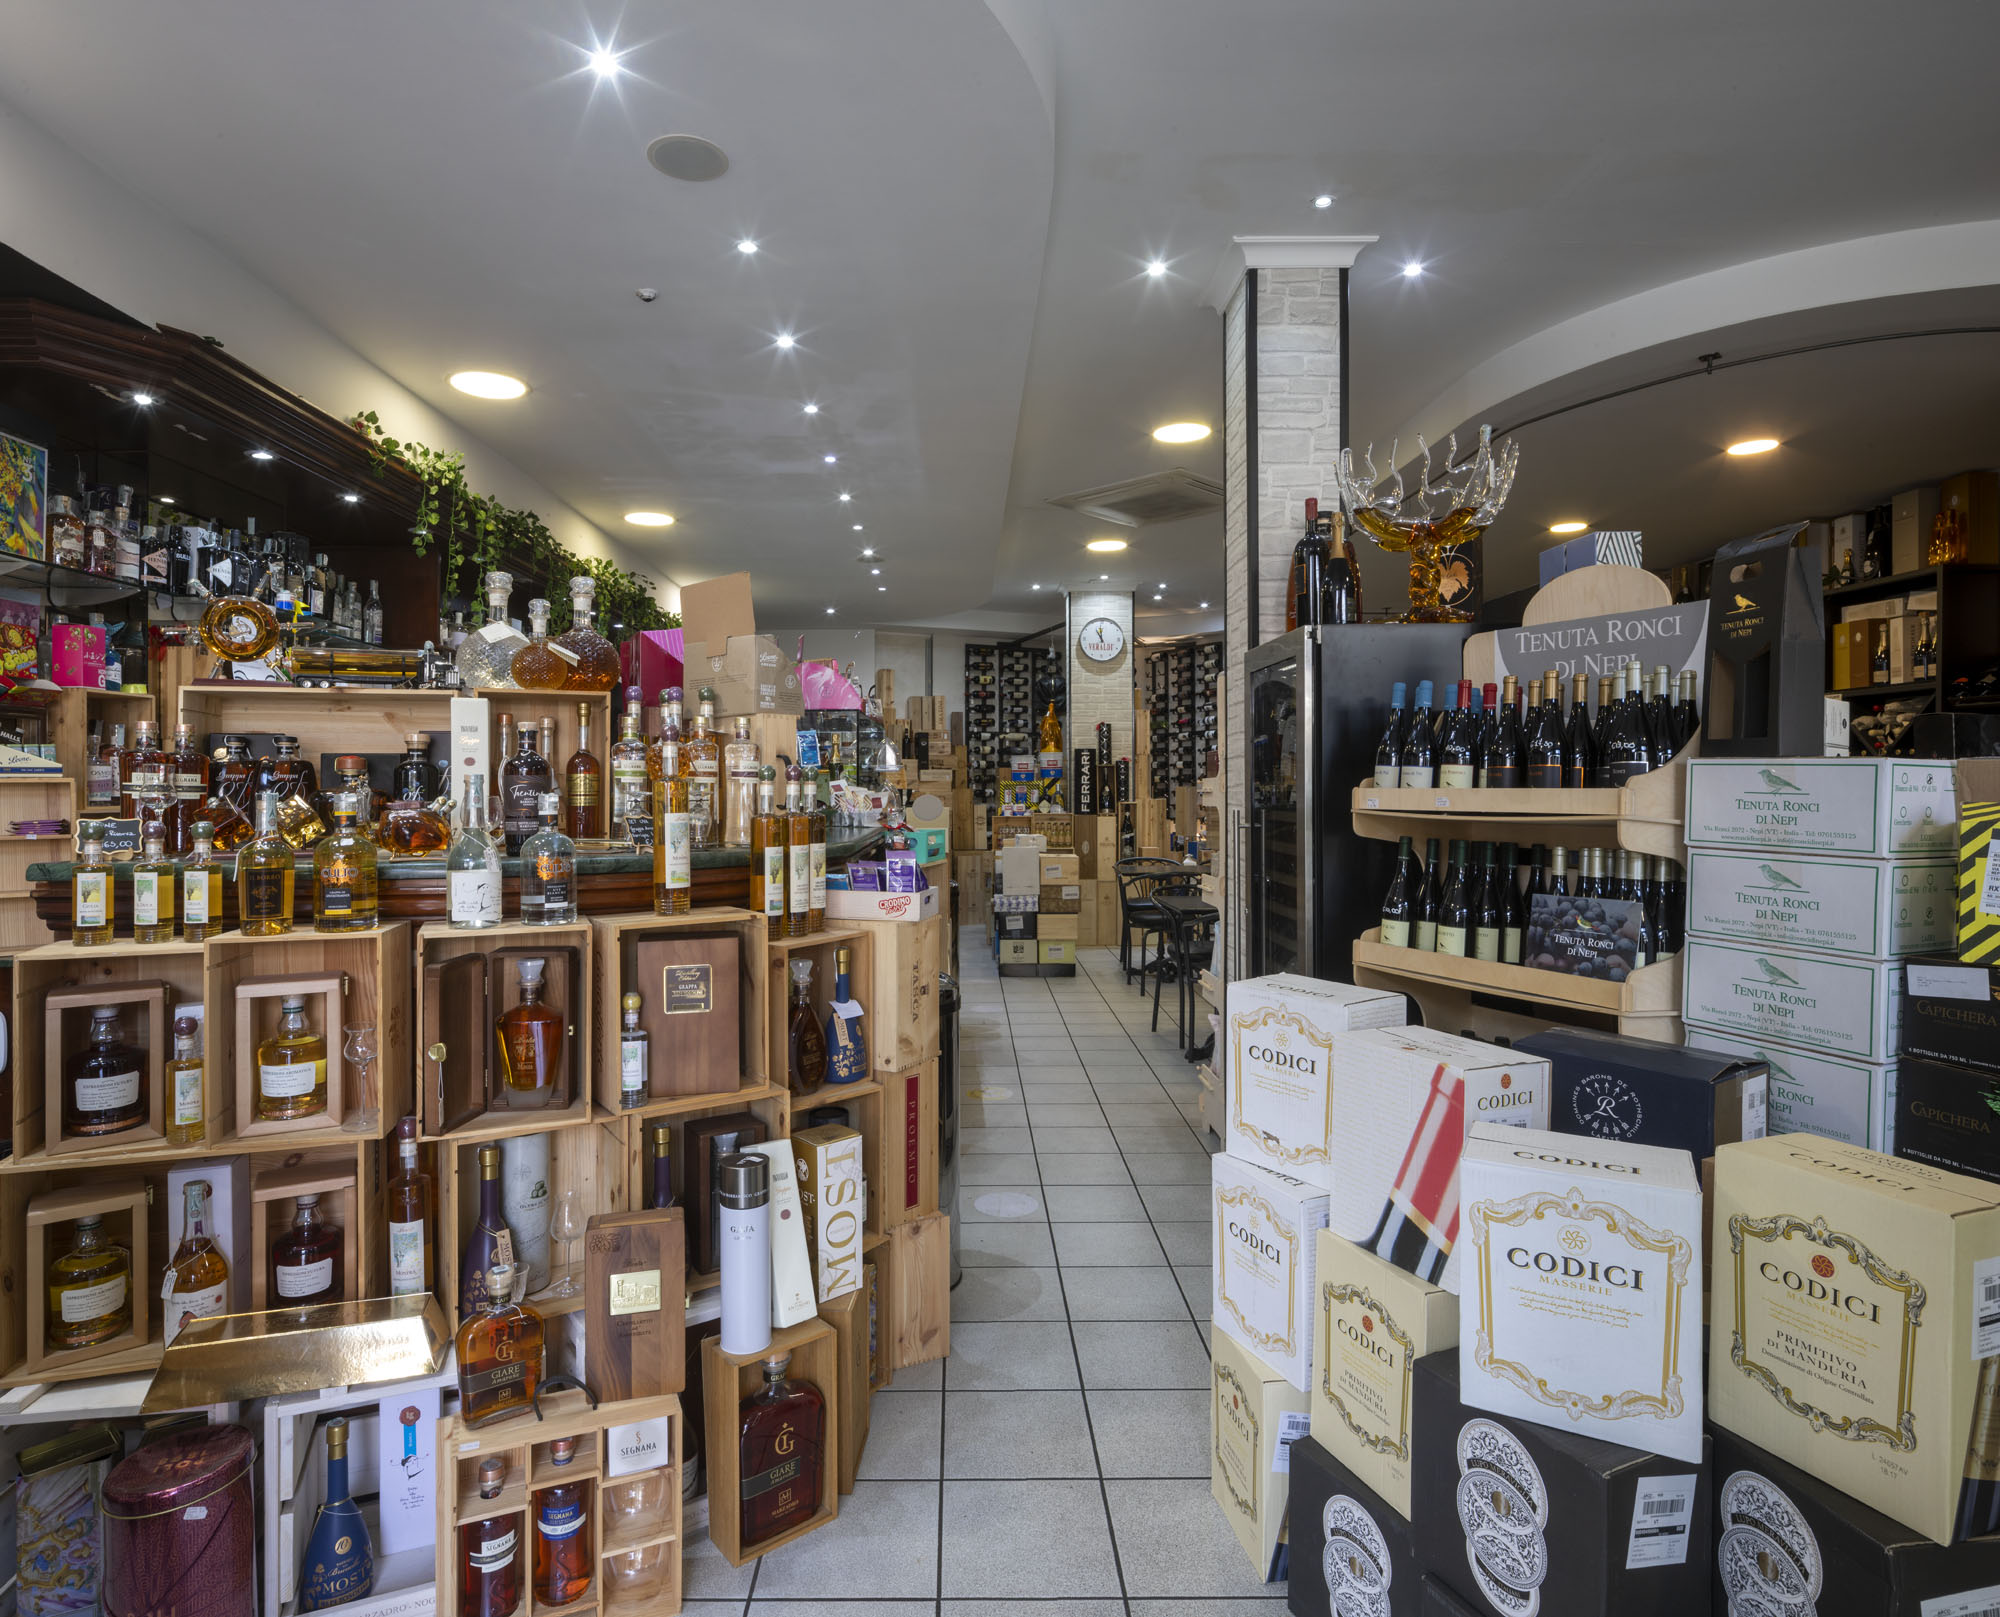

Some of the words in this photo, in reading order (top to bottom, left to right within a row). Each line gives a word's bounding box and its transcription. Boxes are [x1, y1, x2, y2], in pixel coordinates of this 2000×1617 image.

[1515, 628, 1600, 654] TENUTA
[1606, 615, 1683, 643] RONCI
[1720, 619, 1742, 632] TENUTA
[1743, 616, 1765, 627] RONCI
[1730, 630, 1738, 638] DI
[1738, 627, 1753, 638] NEPI
[1555, 659, 1577, 680] DI
[1584, 652, 1637, 677] NEPI
[1, 730, 22, 744] HALLS
[510, 784, 545, 800] Trentin
[1081, 750, 1090, 812] FERRARI
[1736, 798, 1780, 812] TENUTA
[1783, 800, 1820, 812] RONCI
[1750, 828, 1764, 836] Nepi
[1765, 828, 1779, 836] (VT)
[1756, 814, 1770, 825] DI
[1770, 815, 1798, 826] NEPI
[321, 868, 358, 878] CULTO
[878, 896, 912, 910] CRODINO
[1735, 891, 1780, 907] TENUTA
[1782, 896, 1820, 911] RONCI
[1714, 916, 1731, 924] Ronci
[1750, 920, 1764, 930] Nepi
[1765, 923, 1780, 931] (VT)
[1784, 925, 1800, 933] Italia
[1756, 909, 1768, 919] DI
[1771, 910, 1799, 923] NEPI
[1554, 934, 1586, 947] TENUTA
[1588, 937, 1614, 950] RONCI
[1567, 948, 1576, 956] DI
[1577, 947, 1598, 960] NEPI
[912, 961, 920, 1024] TASCA
[1266, 982, 1337, 999] CODICI
[1732, 984, 1776, 1001] TENUTA
[1780, 991, 1816, 1009] RONCI
[1700, 1004, 1711, 1012] Via
[1711, 1007, 1728, 1016] Ronci
[1746, 1014, 1761, 1024] Nepi
[1762, 1017, 1776, 1026] (VT)
[1780, 1020, 1796, 1029] Italia
[1753, 1002, 1764, 1012] DI
[1768, 1004, 1794, 1019] NEPI
[1916, 1000, 1998, 1027] CAPICHERA
[1248, 1045, 1316, 1074] CODICI
[1913, 1048, 1939, 1058] BOTTIGLIE
[1478, 1090, 1534, 1111] CODICI
[1572, 1086, 1585, 1125] DOMAINES
[1581, 1074, 1613, 1084] BARONS
[1617, 1080, 1628, 1089] DE
[1626, 1091, 1643, 1138] ROTHSCHILD
[1777, 1086, 1814, 1106] RONCI
[1911, 1100, 1992, 1135] CAPICHERA
[908, 1100, 917, 1184] PROEMIO
[1513, 1151, 1642, 1175] CODICI
[1908, 1148, 1932, 1159] BOTTIGLIE
[1952, 1160, 1960, 1168] ML
[1790, 1152, 1916, 1192] CODICI
[824, 1146, 857, 1297] MOST
[1229, 1222, 1282, 1265] CODICI
[1507, 1247, 1644, 1291] CODICI
[1539, 1274, 1612, 1296] MASSERIE
[1760, 1262, 1881, 1326] CODICI
[1337, 1318, 1394, 1368] CODICI
[1776, 1328, 1858, 1373] PRIMITIVO
[491, 1364, 521, 1380] GIARE
[1761, 1346, 1804, 1376] Denominazione
[1806, 1366, 1813, 1378] di
[1814, 1370, 1838, 1390] Origine
[1766, 1338, 1782, 1351] DI
[1784, 1343, 1867, 1390] MANDURIA
[1340, 1376, 1346, 1384] DI
[1348, 1380, 1388, 1416] MANDURIA
[1344, 1370, 1384, 1403] PRIMITIVO
[1220, 1394, 1249, 1442] CODICI
[620, 1442, 657, 1456] SEGNANA
[770, 1462, 796, 1480] GIARE
[1470, 1460, 1489, 1472] LUPO
[1490, 1465, 1535, 1512] MERAVIGLIA
[548, 1510, 574, 1520] SEGNANA
[486, 1538, 512, 1552] SEGNANA
[1736, 1514, 1756, 1526] LUPO
[1758, 1520, 1806, 1576] MERAVIGLIA
[323, 1566, 366, 1594] MOST
